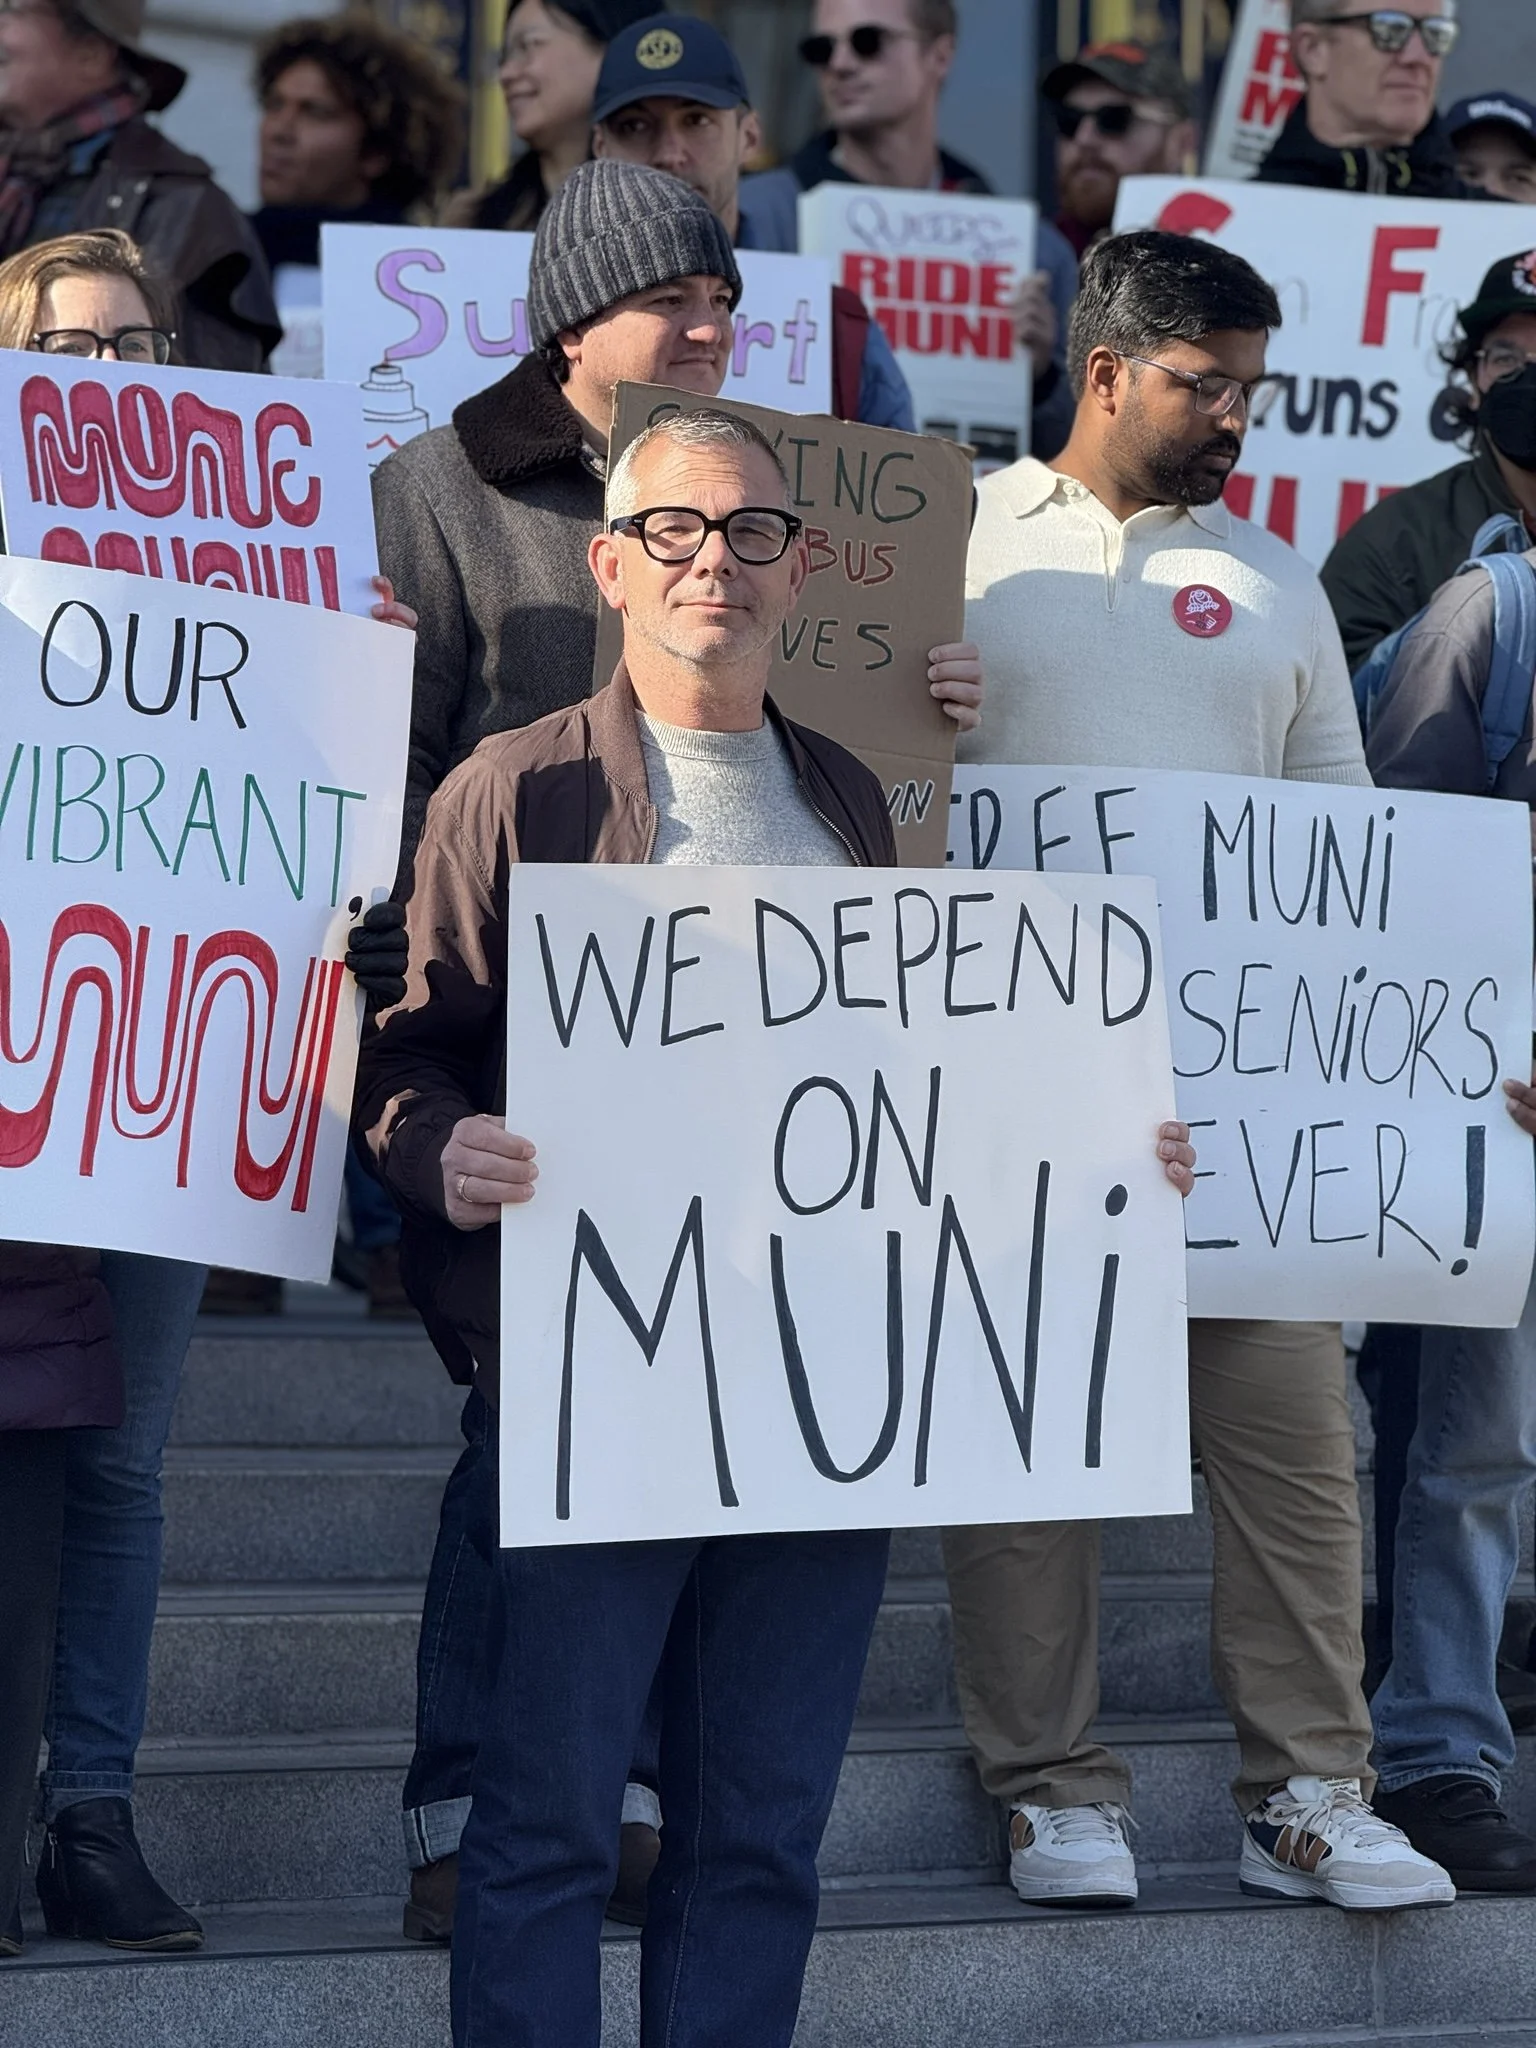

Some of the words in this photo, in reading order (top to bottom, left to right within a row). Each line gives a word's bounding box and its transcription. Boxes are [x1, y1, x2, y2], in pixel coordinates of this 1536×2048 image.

[376, 248, 817, 385] Surt
[842, 254, 1014, 309] RIDE
[804, 527, 898, 586] BUS
[41, 600, 248, 729] OUR
[780, 615, 893, 671] VES
[535, 905, 724, 1047] WE
[755, 888, 1153, 1028] DEPEND
[774, 1065, 942, 1215] ON
